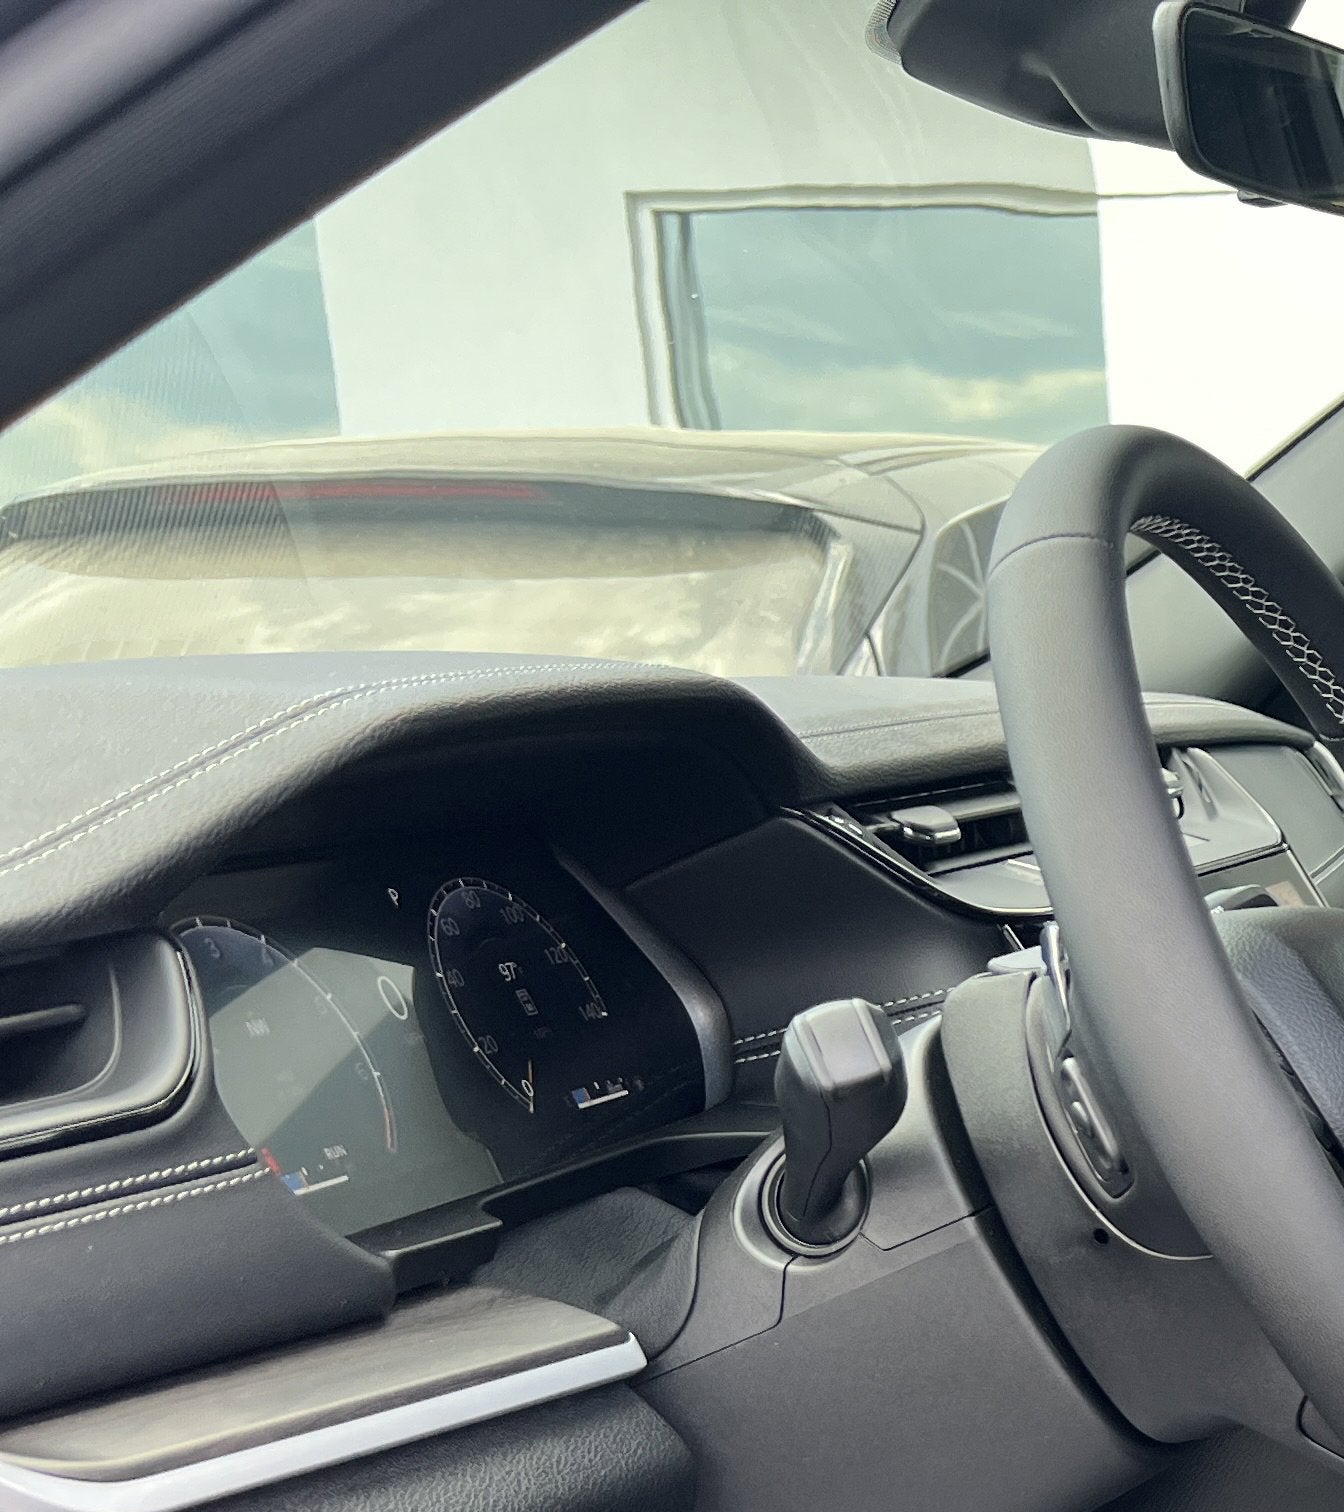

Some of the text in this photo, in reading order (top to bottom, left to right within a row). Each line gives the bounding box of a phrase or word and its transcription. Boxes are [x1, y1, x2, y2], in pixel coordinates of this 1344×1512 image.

[461, 890, 481, 910] 80
[499, 904, 525, 925] 100
[543, 946, 569, 965] 120
[577, 1001, 603, 1021] 140
[477, 1034, 499, 1055] 20
[323, 1144, 348, 1161] RUN
